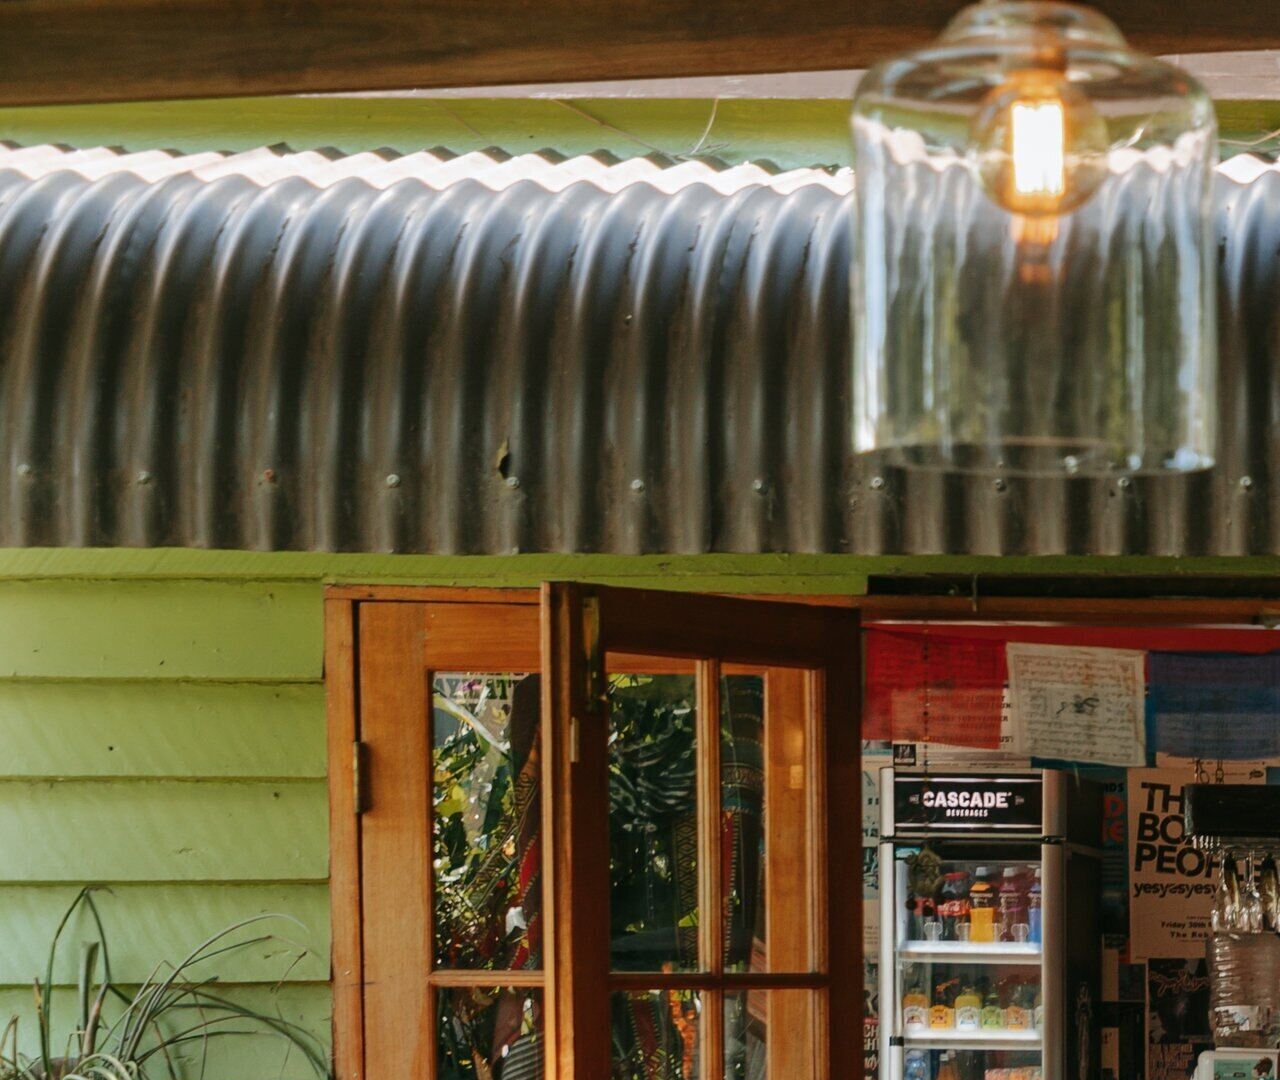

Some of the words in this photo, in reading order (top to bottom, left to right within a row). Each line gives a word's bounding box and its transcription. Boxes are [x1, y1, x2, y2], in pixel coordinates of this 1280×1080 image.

[922, 791, 1009, 808] CASCADE
[1141, 782, 1185, 814] TH
[945, 809, 988, 817] BEVERAGES
[1137, 812, 1193, 845] BO
[1161, 920, 1186, 929] Friday
